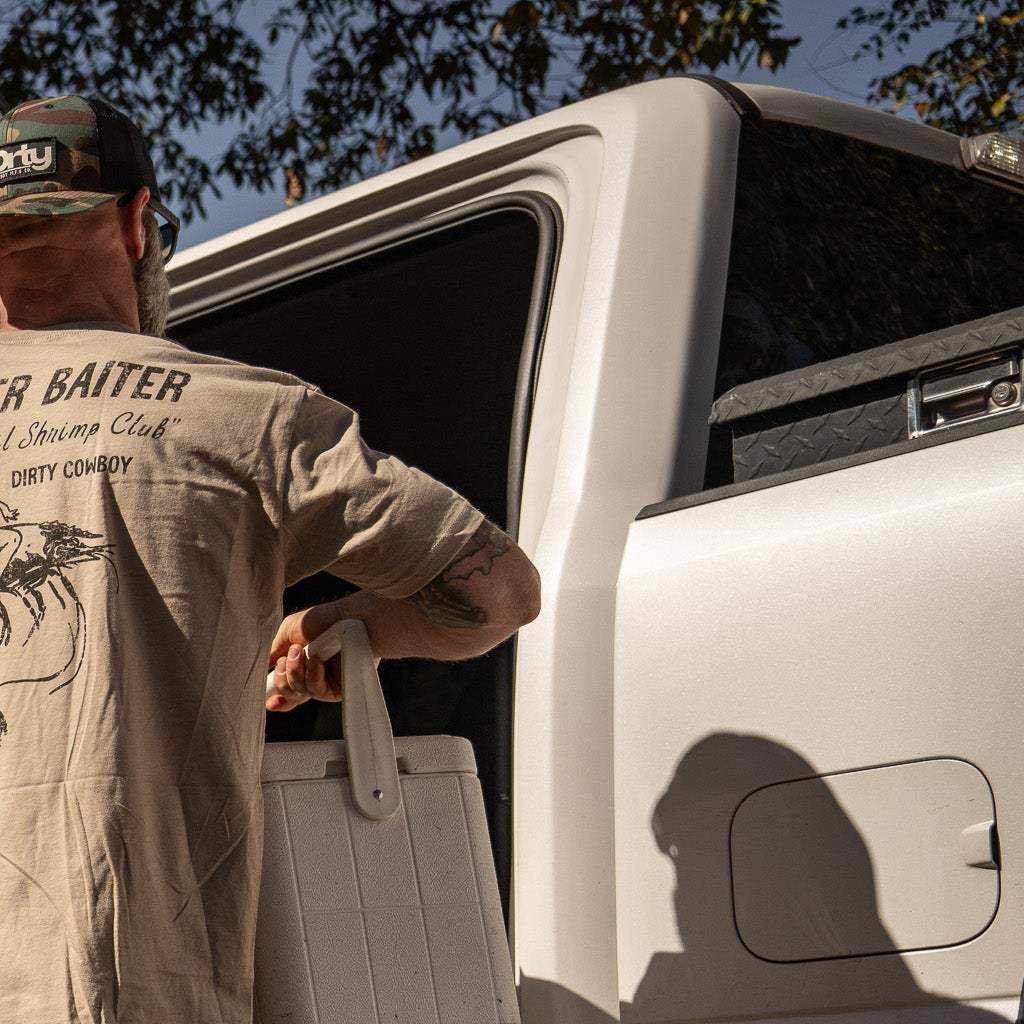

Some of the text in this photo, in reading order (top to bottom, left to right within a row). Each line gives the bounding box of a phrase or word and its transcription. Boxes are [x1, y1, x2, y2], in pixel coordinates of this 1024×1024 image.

[41, 360, 192, 405] BAITER
[18, 419, 100, 449] Shrimp
[12, 455, 134, 488] DIRTY COWBOY
